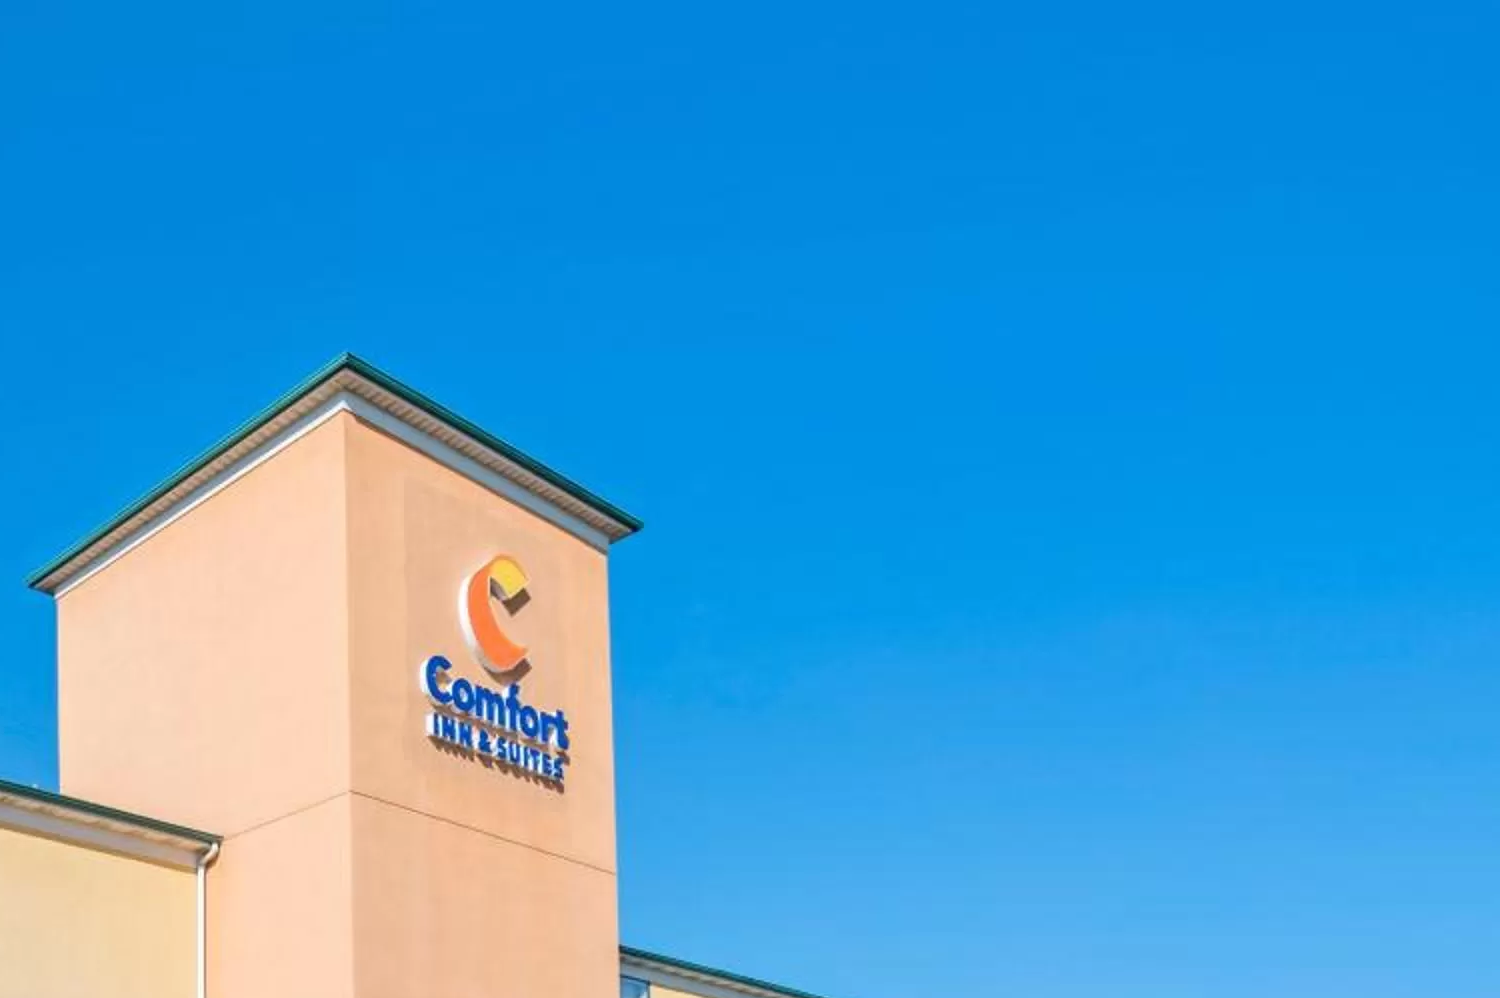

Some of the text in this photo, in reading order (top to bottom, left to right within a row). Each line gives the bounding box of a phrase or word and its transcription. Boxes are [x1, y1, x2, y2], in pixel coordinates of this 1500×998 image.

[421, 655, 570, 749] Comfort
[427, 712, 565, 780] INN & SUITES
